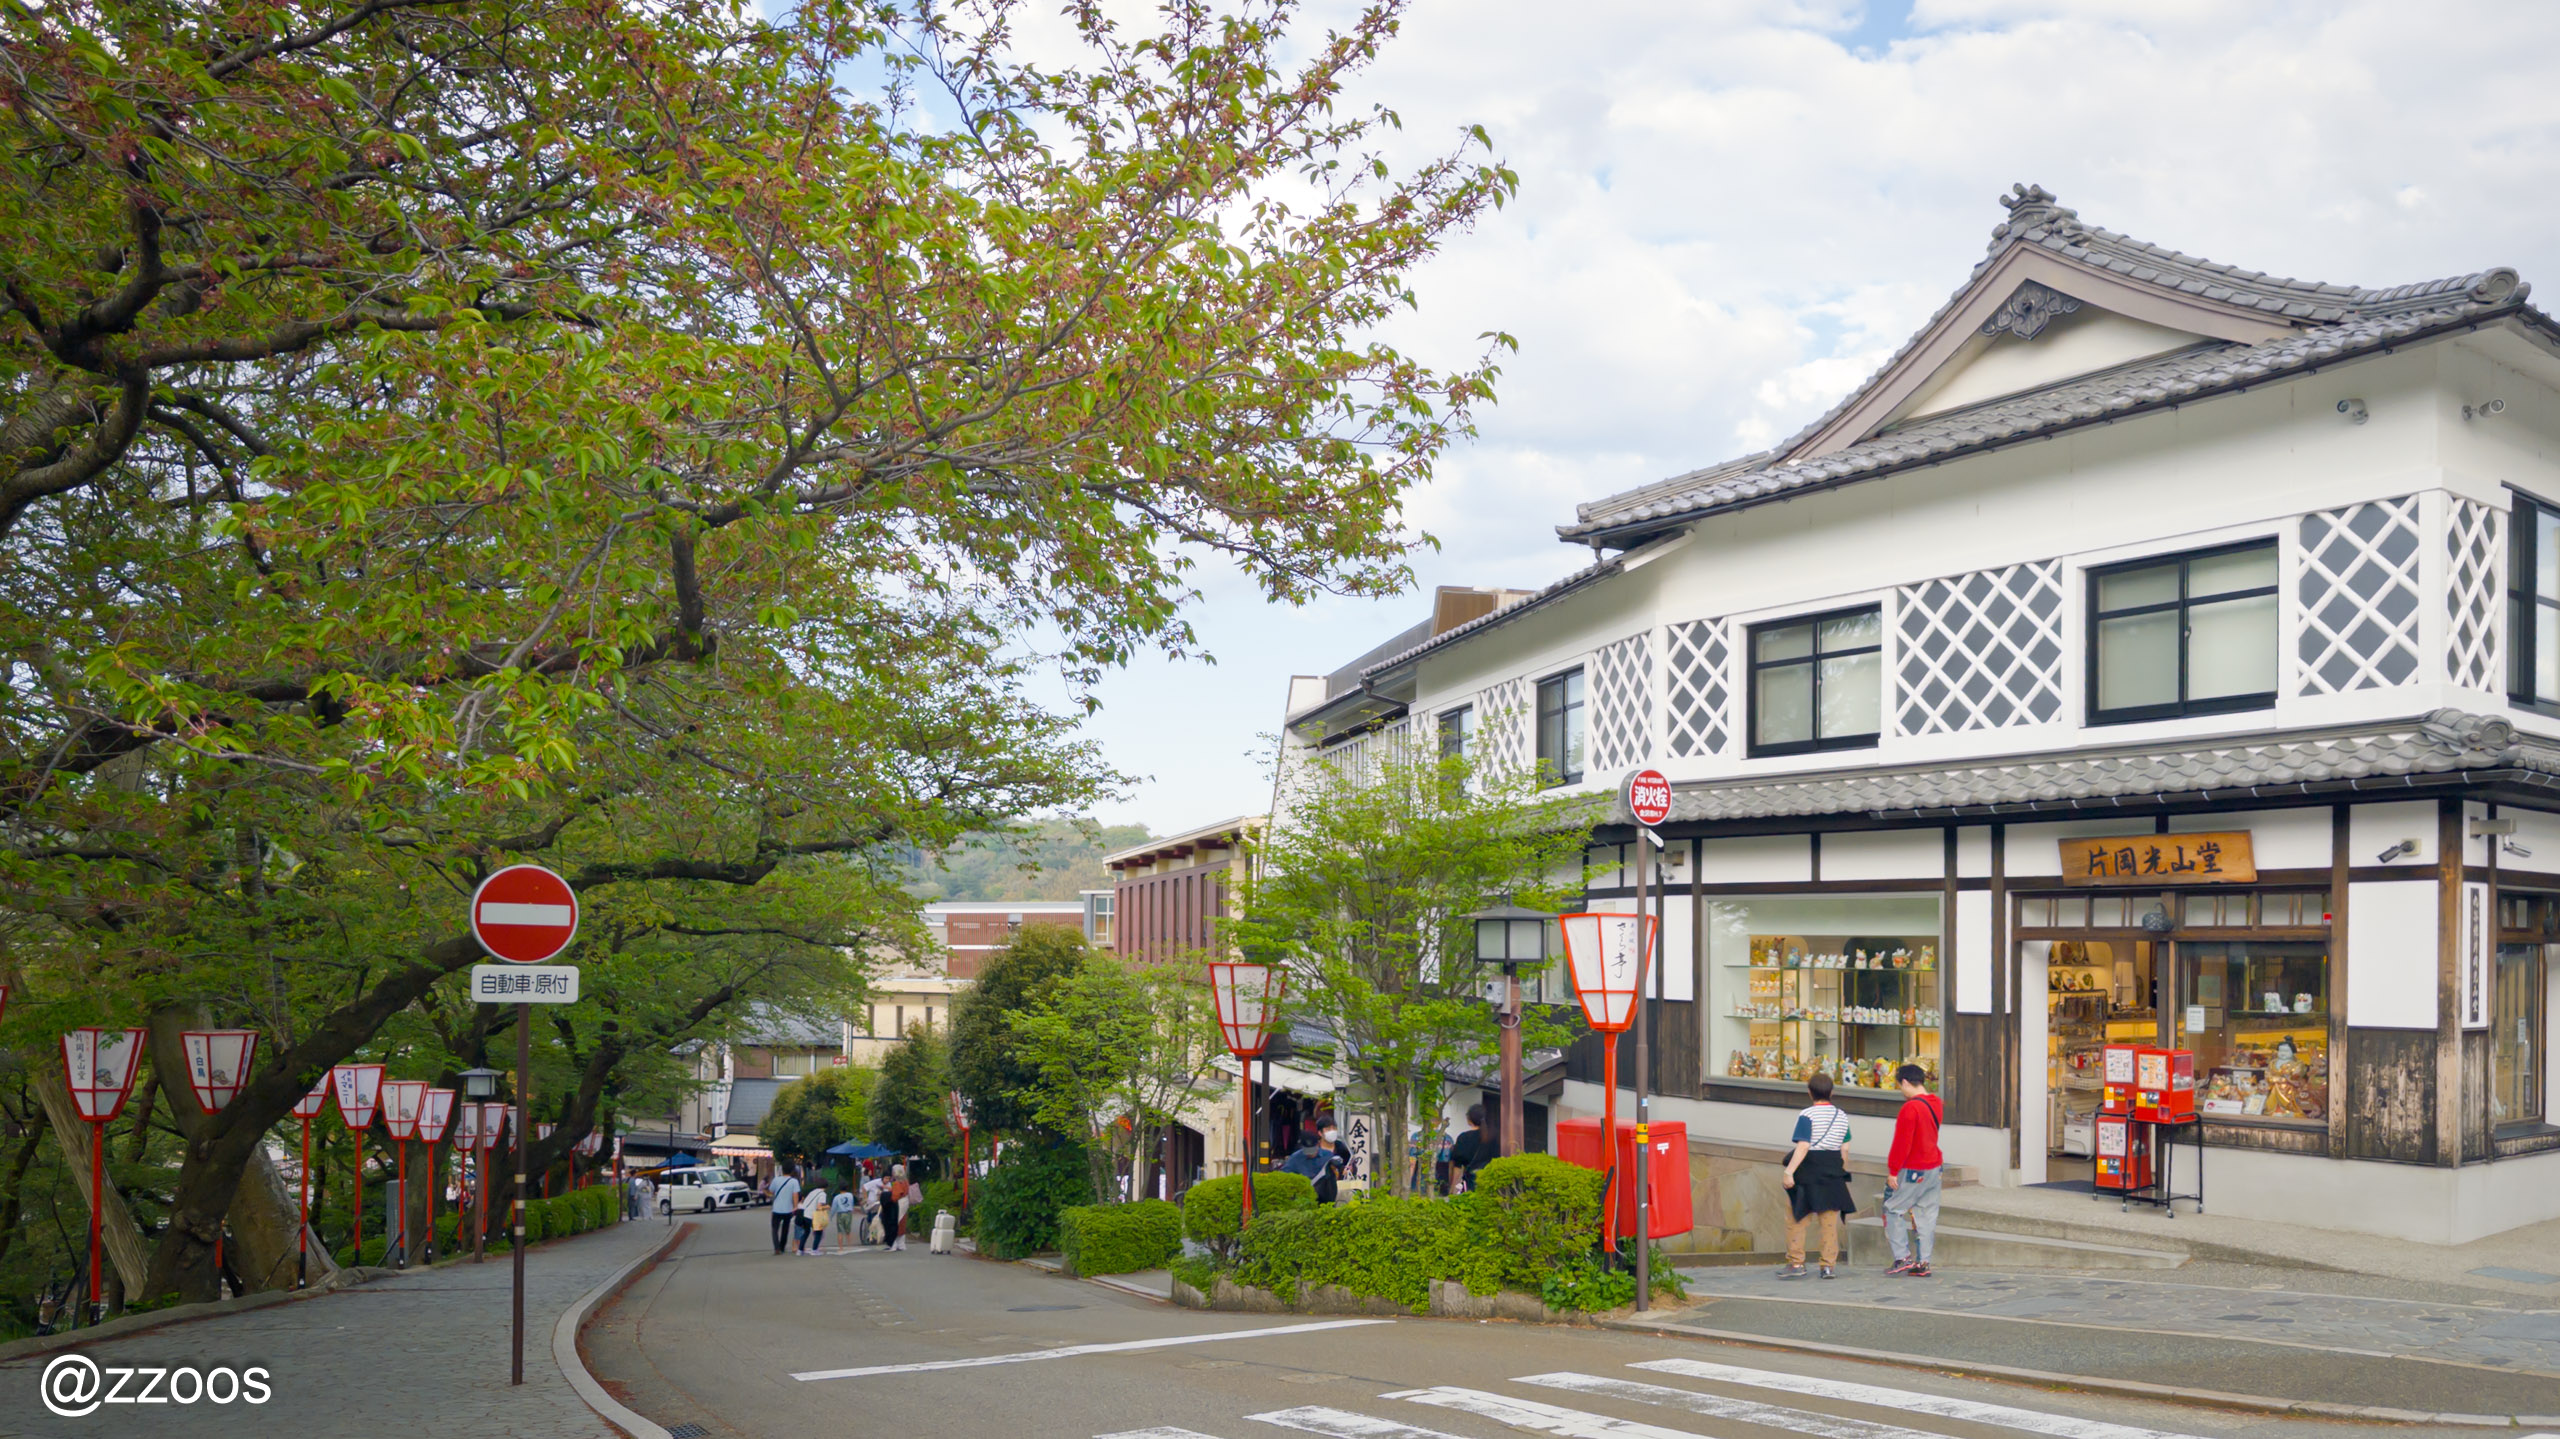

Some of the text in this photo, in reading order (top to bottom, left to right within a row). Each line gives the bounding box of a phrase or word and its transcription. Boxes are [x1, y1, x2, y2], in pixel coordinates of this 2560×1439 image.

[1634, 785, 1668, 808] 消火栓
[2087, 841, 2223, 877] 片岡光山堂
